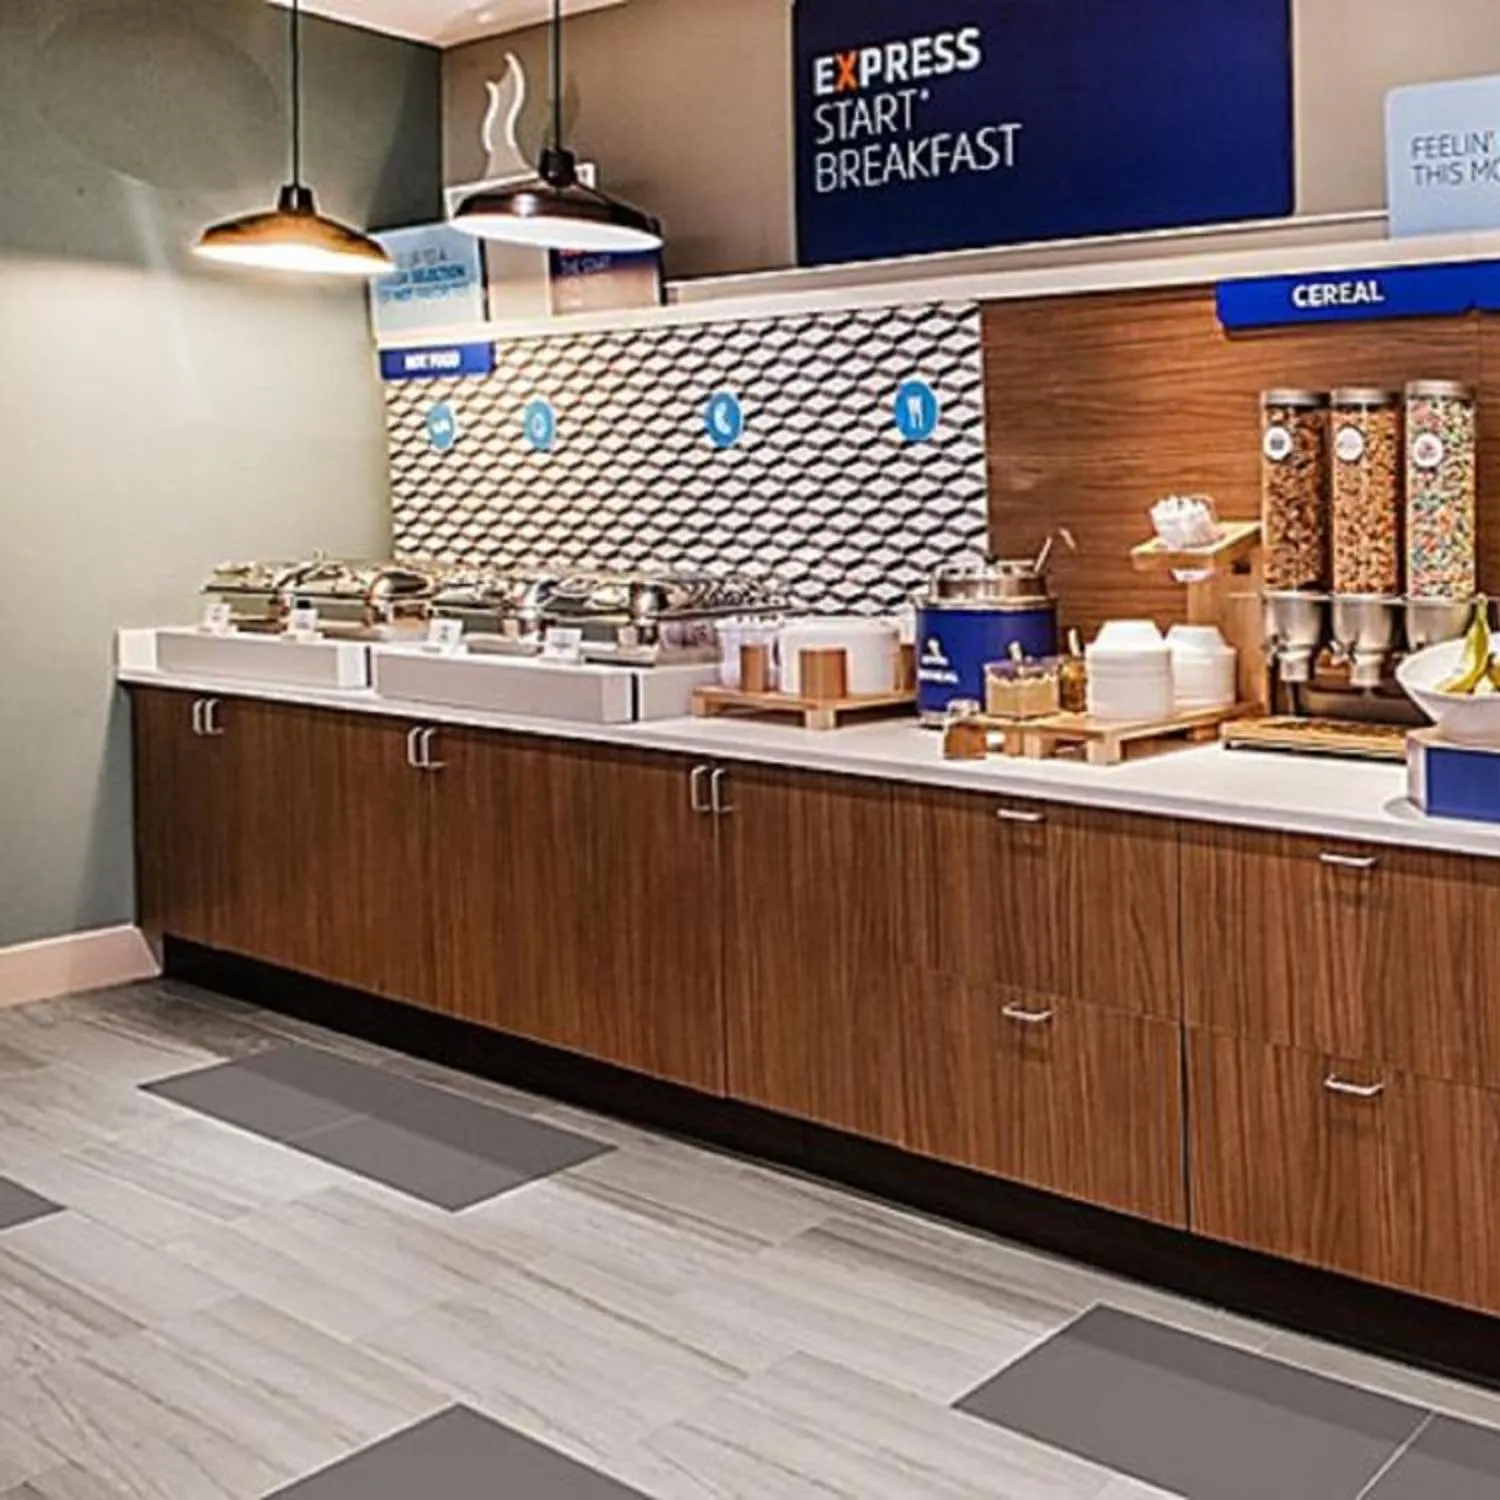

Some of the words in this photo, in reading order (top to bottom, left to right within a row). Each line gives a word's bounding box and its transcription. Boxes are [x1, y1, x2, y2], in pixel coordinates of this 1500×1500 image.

[813, 27, 983, 95] EXPRESS
[815, 122, 1024, 193] BREAKFAST
[1411, 131, 1494, 159] FEELIN'
[1412, 162, 1464, 187] THIS
[1291, 280, 1385, 308] CEREAL
